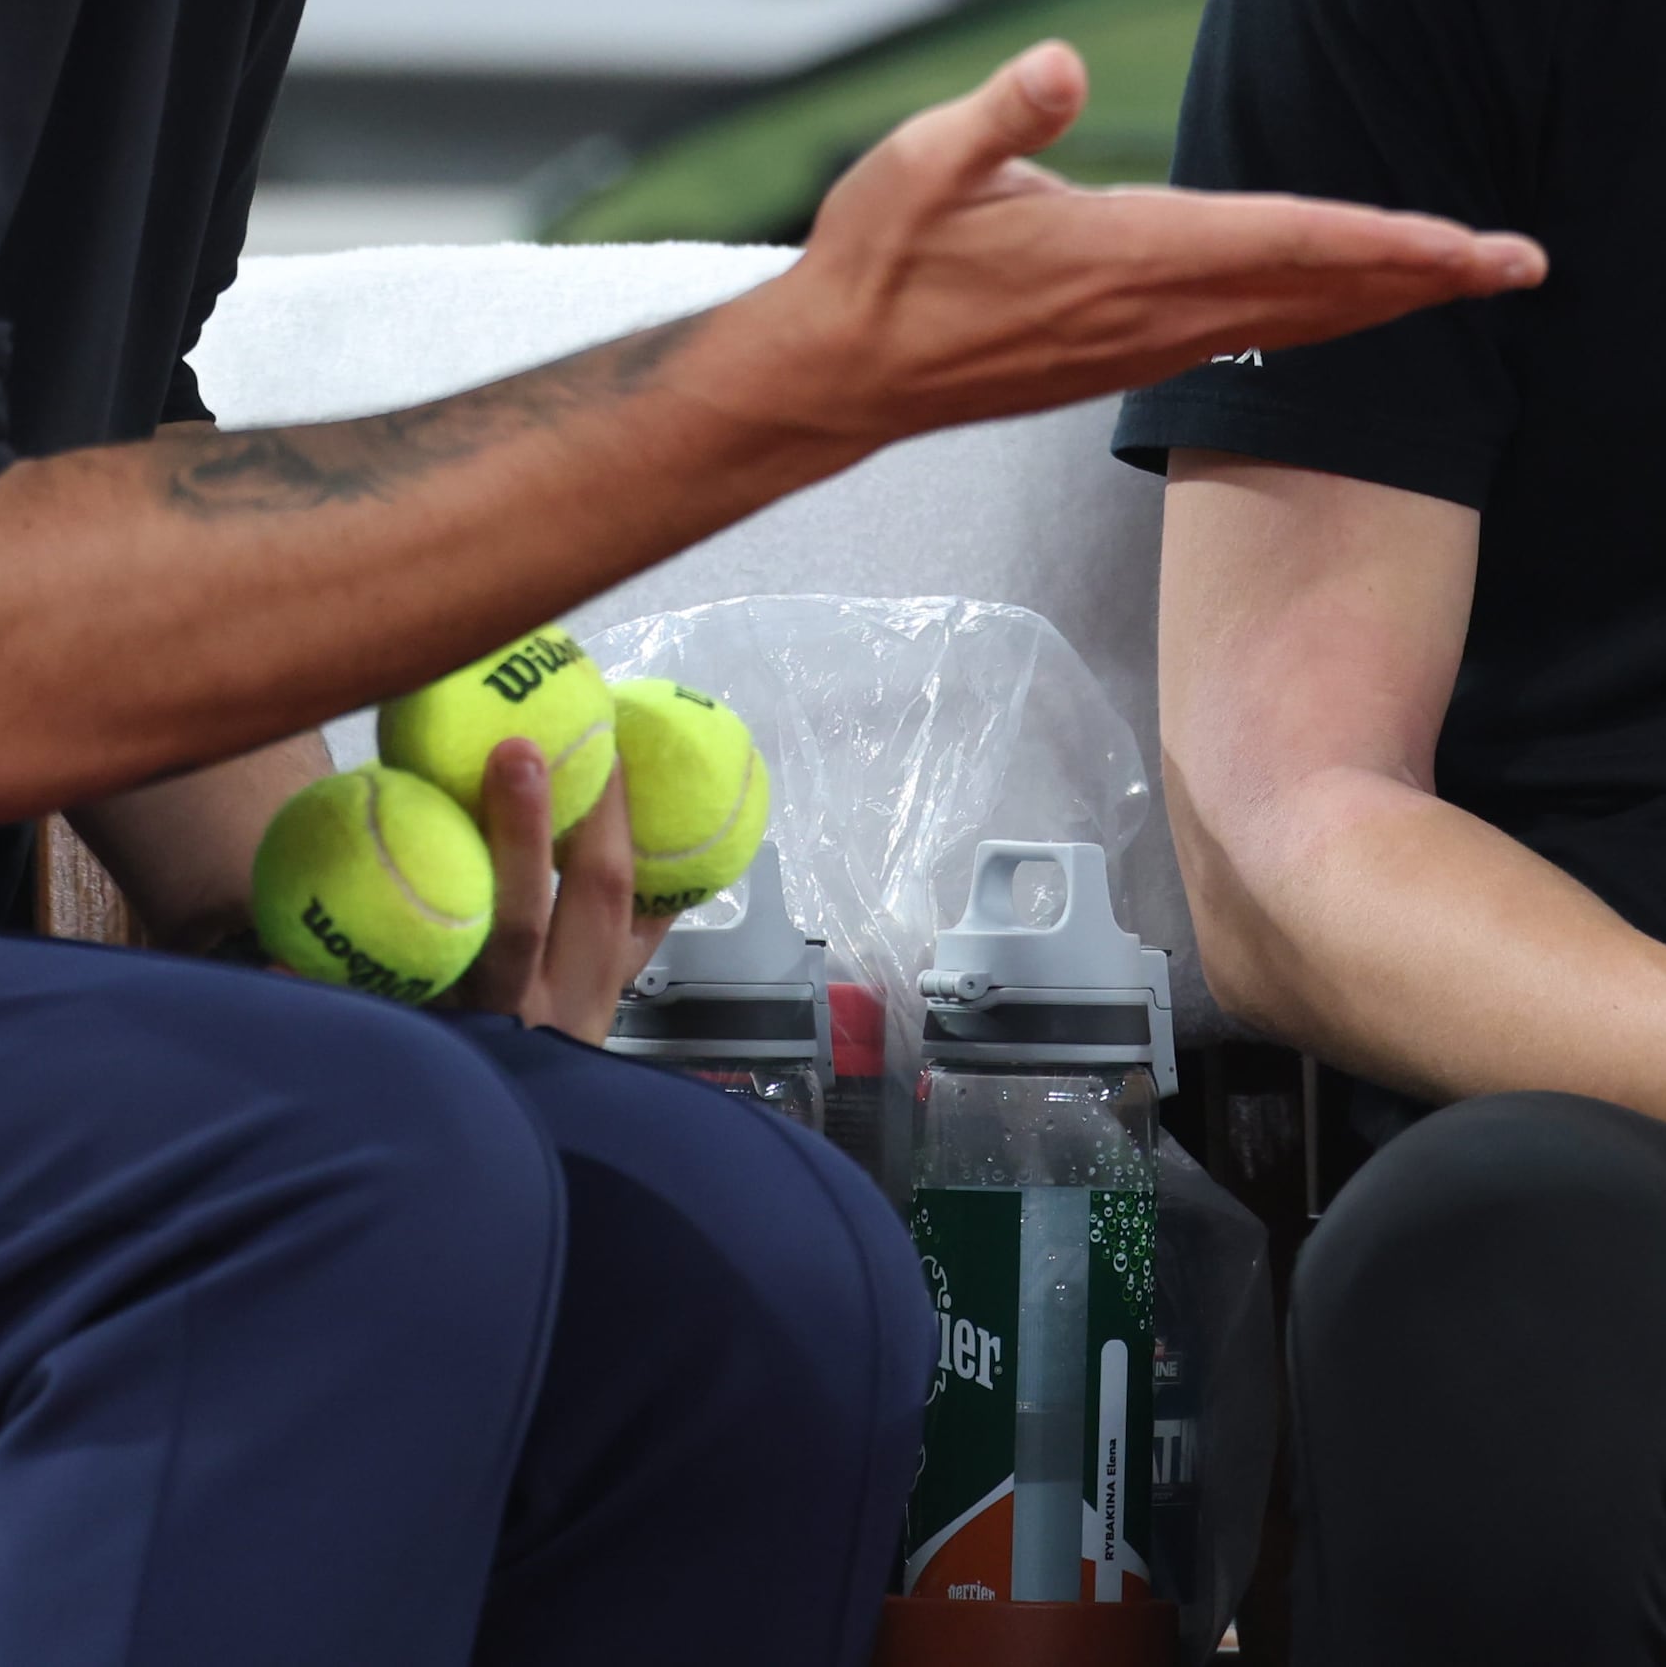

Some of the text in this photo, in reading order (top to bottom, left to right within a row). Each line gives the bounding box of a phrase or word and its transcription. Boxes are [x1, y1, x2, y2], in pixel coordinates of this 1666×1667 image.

[482, 636, 583, 702] Wils
[935, 1293, 1001, 1391] ier
[1104, 1438, 1117, 1561] RYBAKINA Elena
